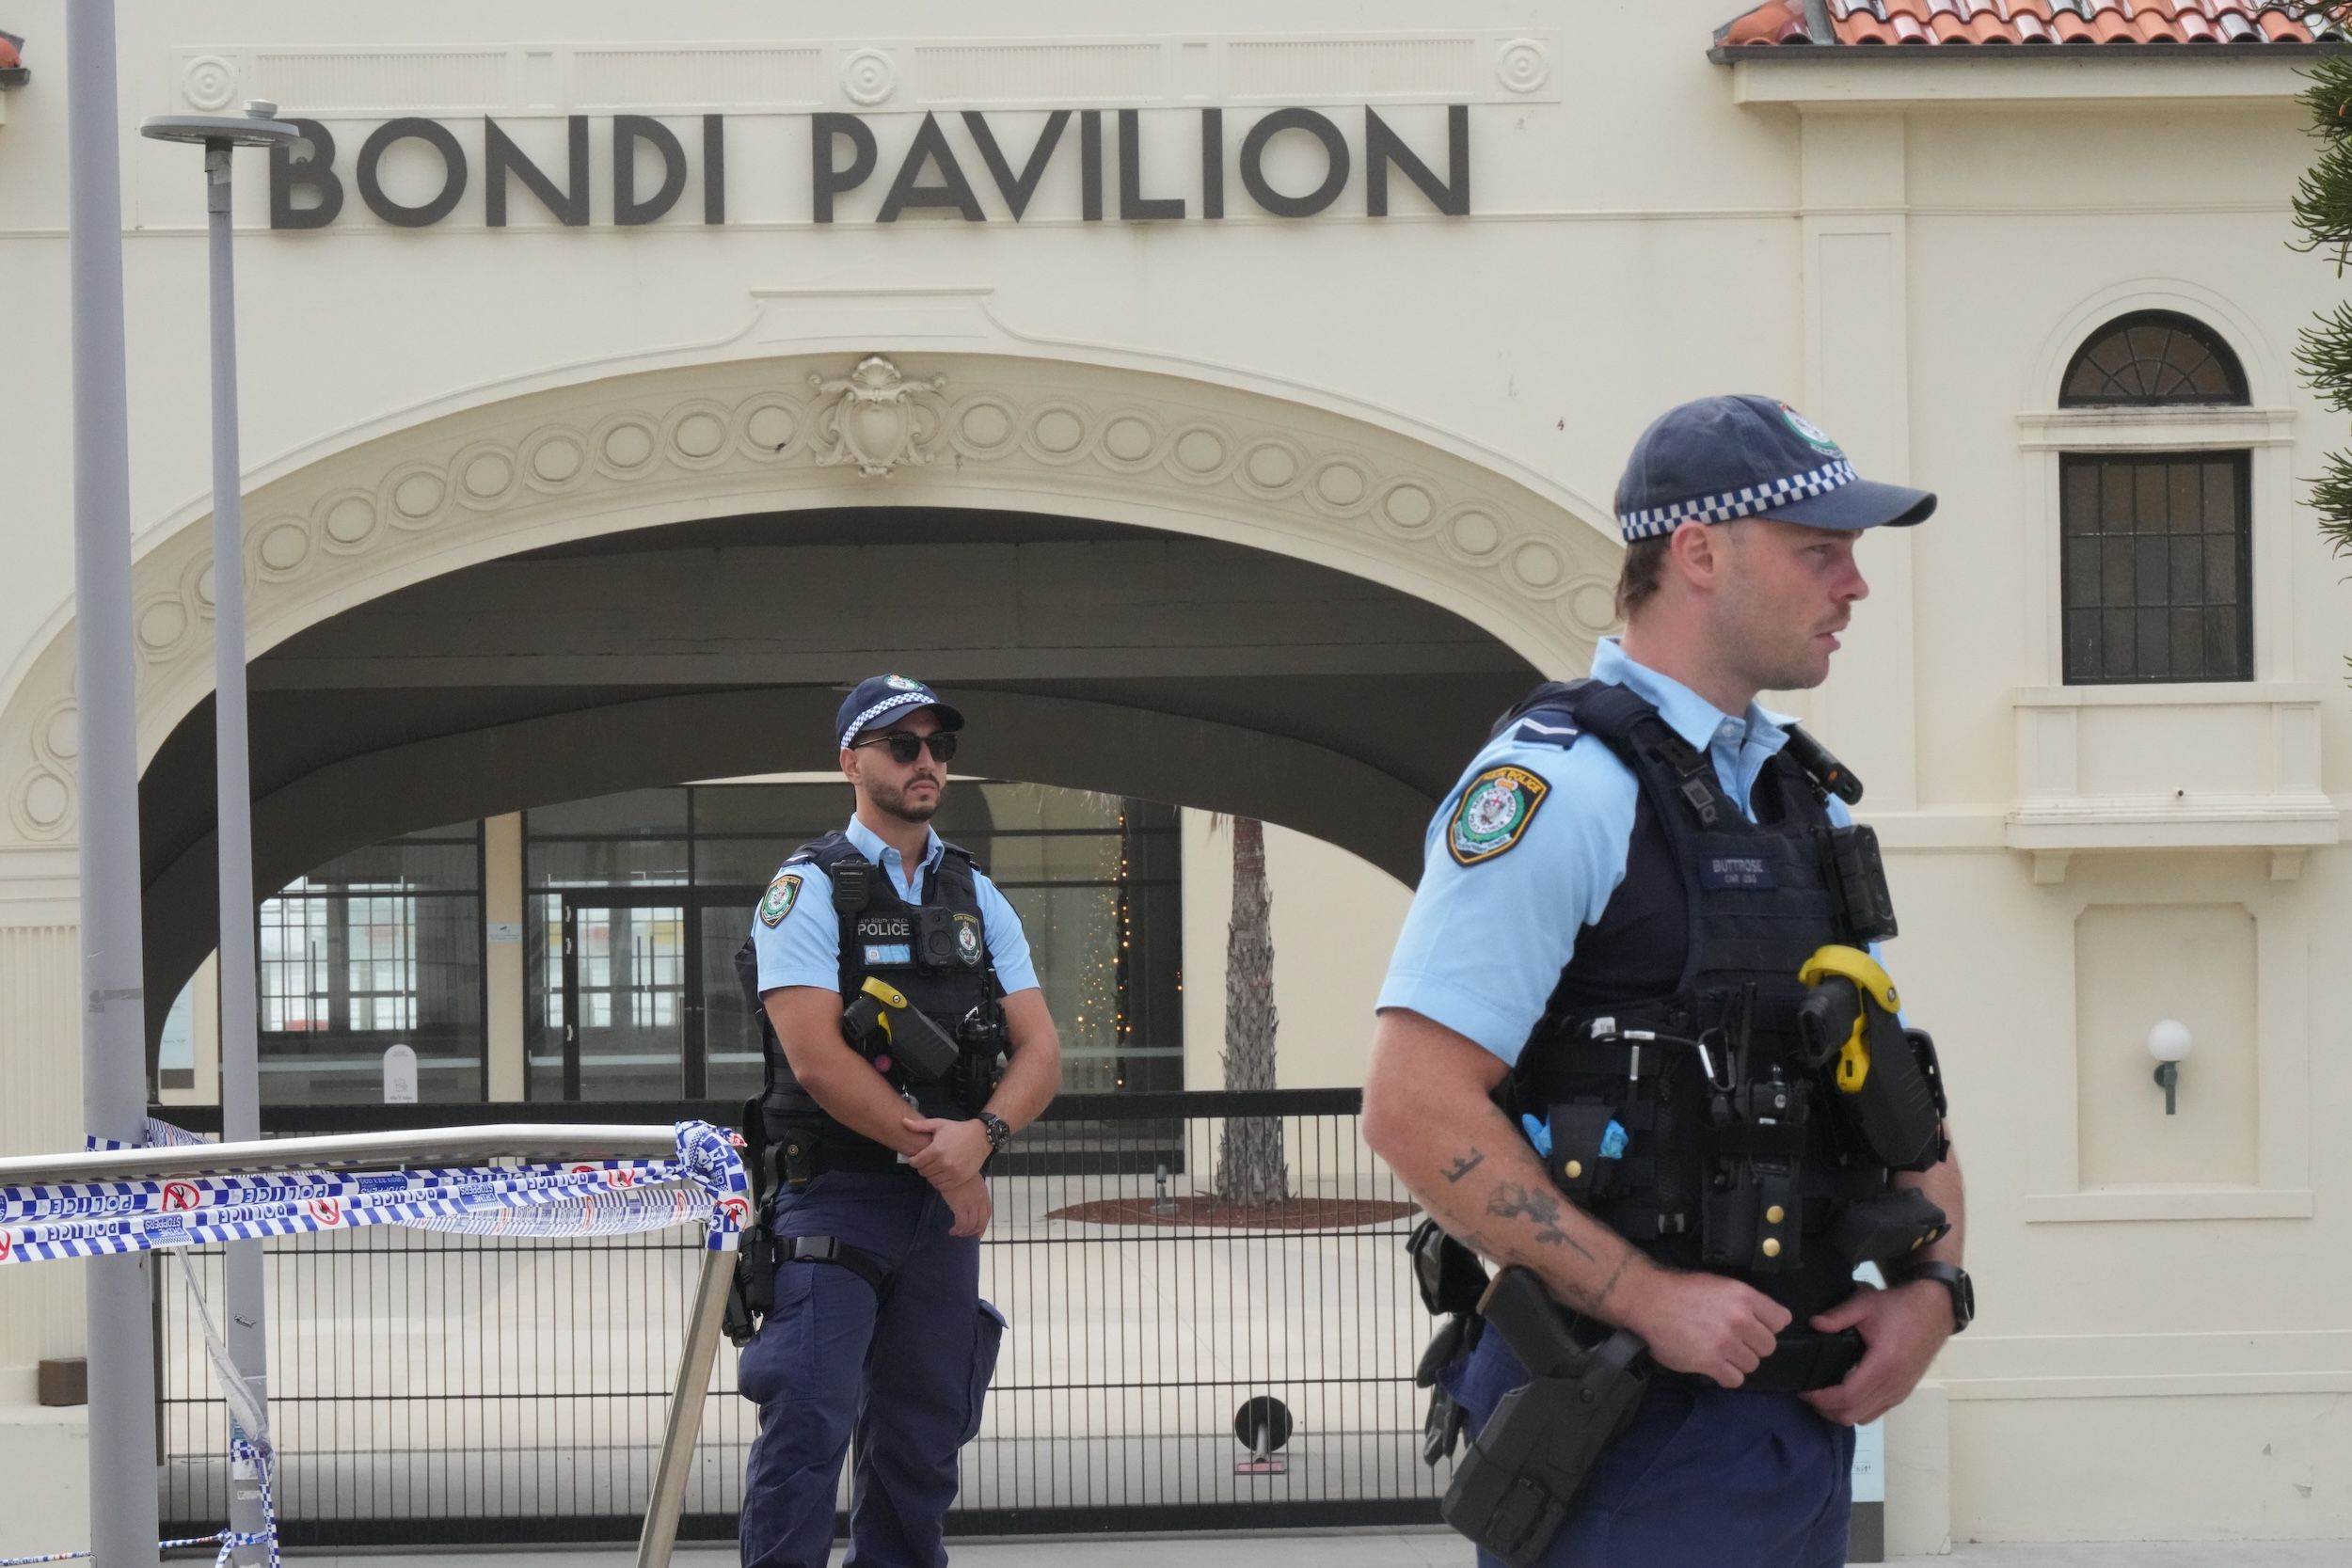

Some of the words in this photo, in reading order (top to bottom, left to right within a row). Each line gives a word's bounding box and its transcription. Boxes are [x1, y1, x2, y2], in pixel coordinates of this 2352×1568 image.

[270, 113, 724, 230] BONDI
[812, 103, 1470, 223] PAVILION
[1507, 770, 1542, 794] POLICE
[1712, 859, 1763, 873] BUTTROSE
[858, 923, 910, 936] POLICE
[459, 1182, 494, 1196] STOPPERS
[528, 1172, 588, 1190] POLICE
[243, 1185, 328, 1204] POLICE
[372, 1188, 436, 1207] POLICE
[473, 1193, 496, 1203] CRIME
[50, 1196, 132, 1215] POLICE
[218, 1204, 285, 1224] POLICE
[145, 1215, 182, 1229] STOPPERS
[48, 1223, 117, 1242] POLICE
